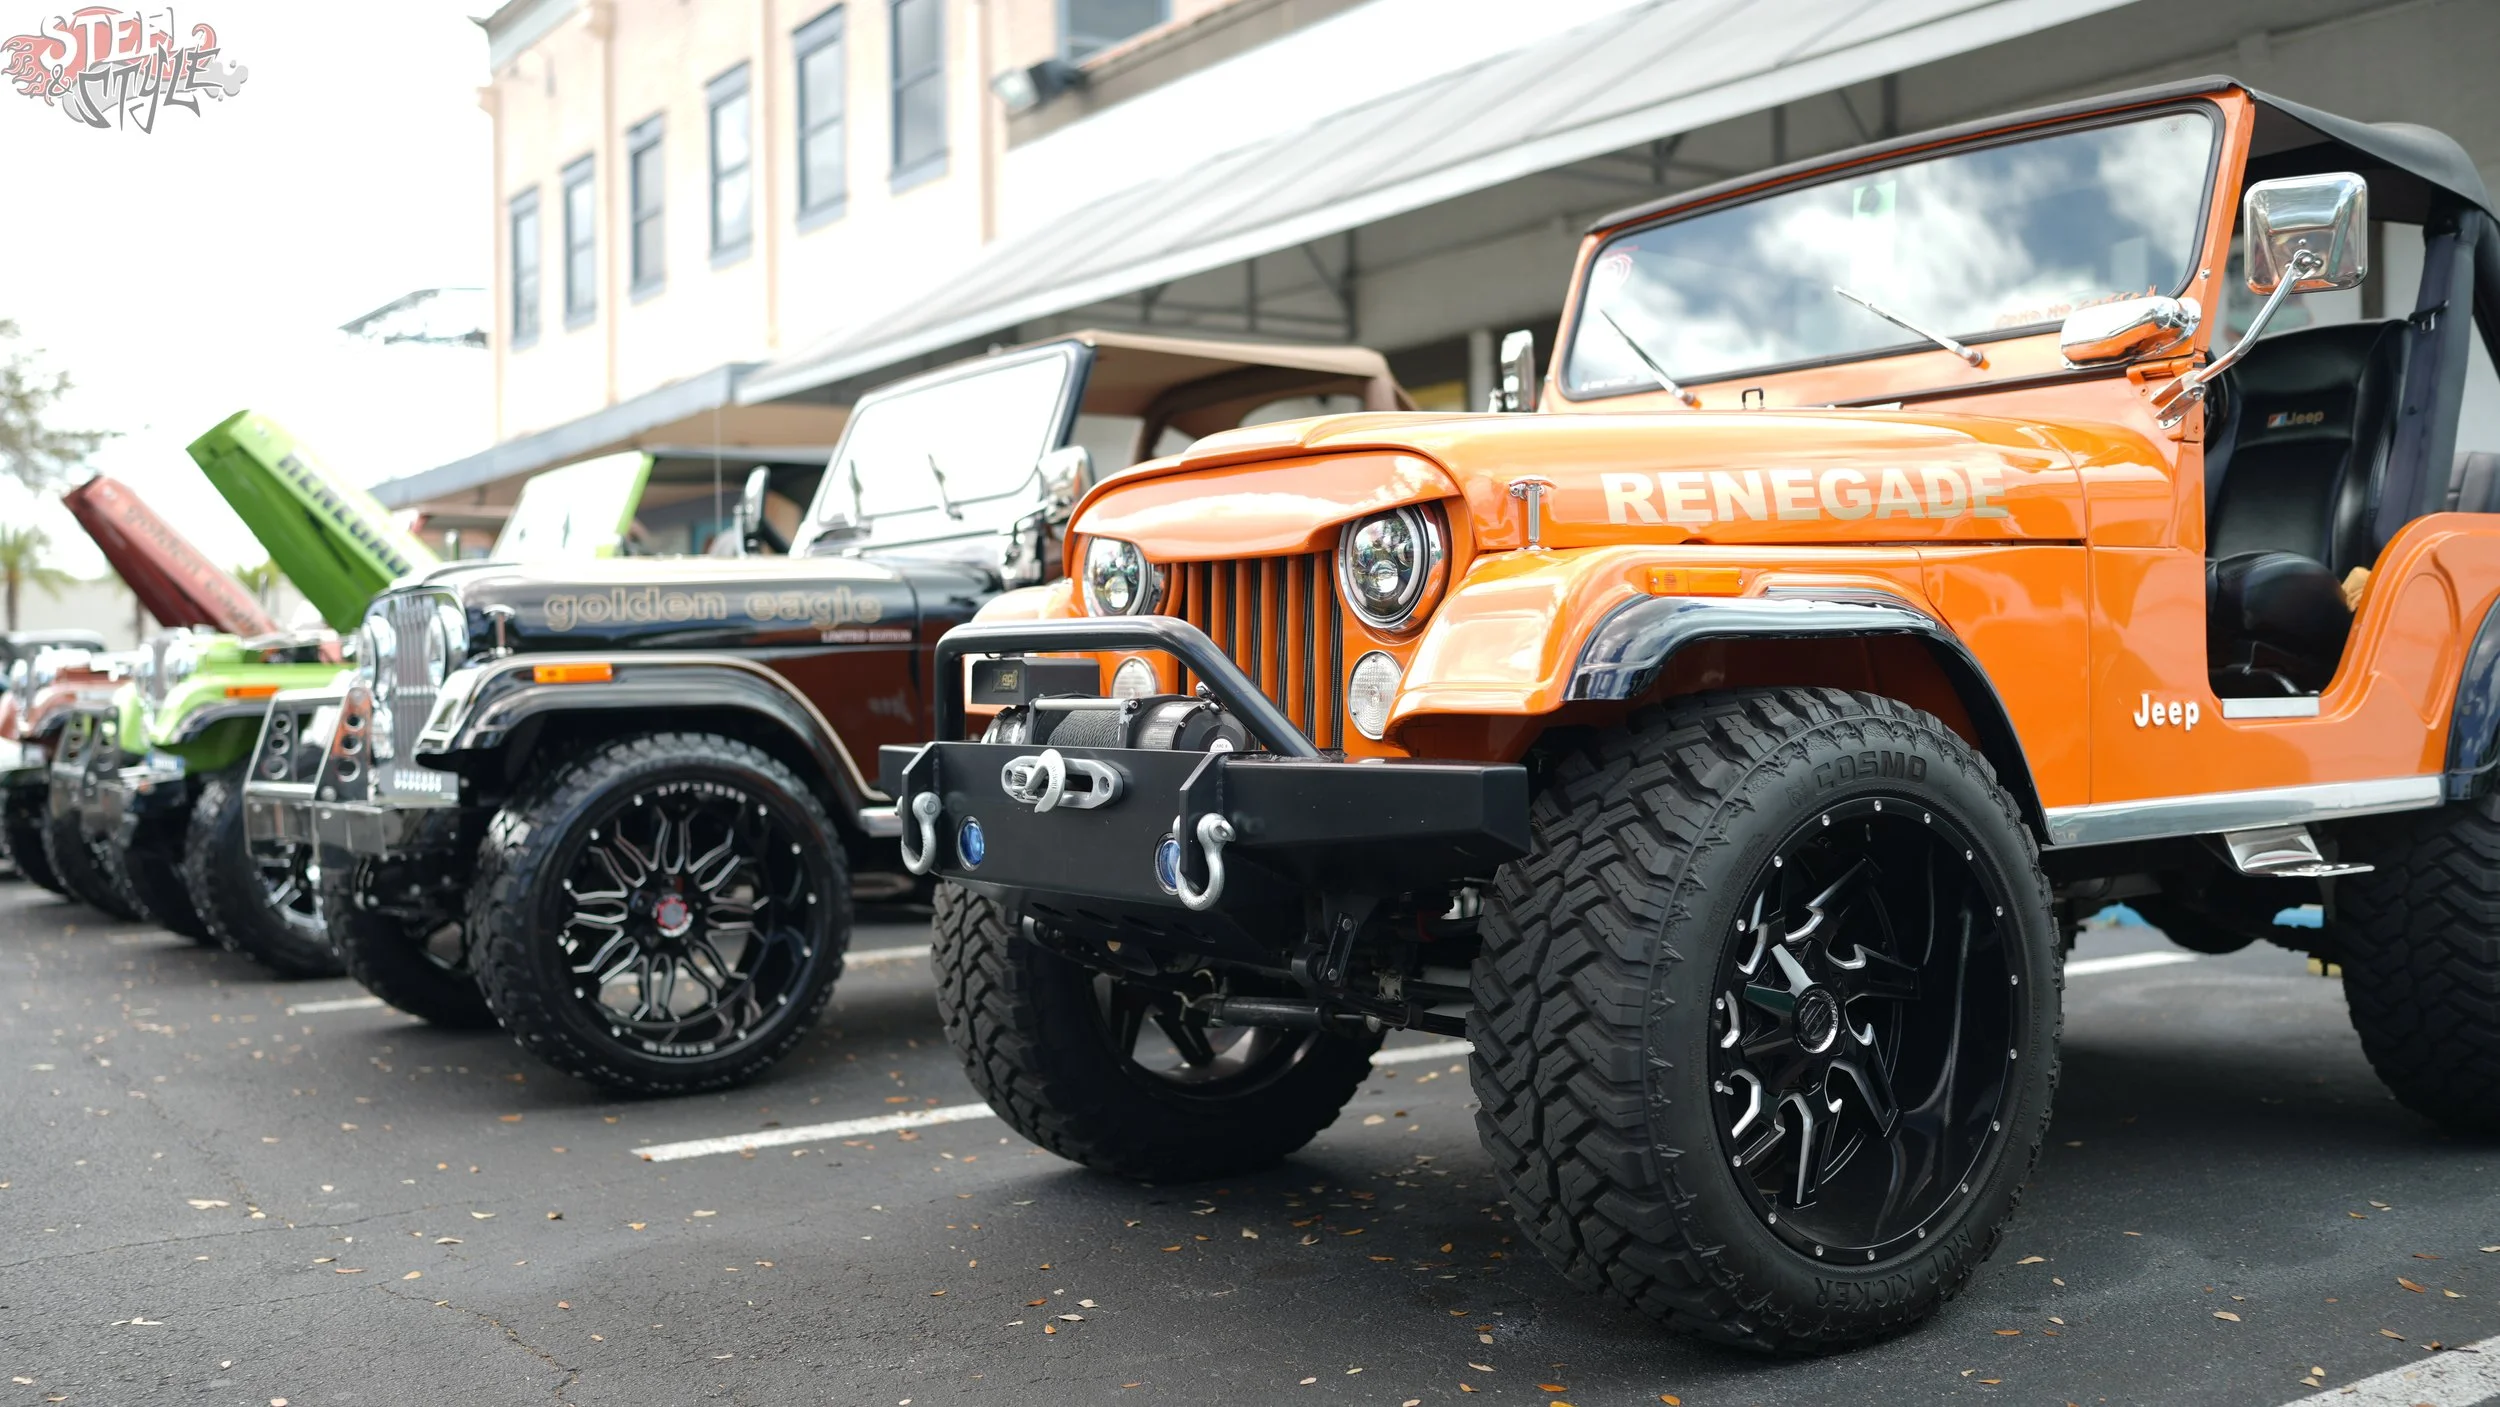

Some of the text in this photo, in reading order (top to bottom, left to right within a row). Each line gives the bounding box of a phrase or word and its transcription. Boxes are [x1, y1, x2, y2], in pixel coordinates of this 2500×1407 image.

[2286, 411, 2325, 426] Jeep
[1600, 467, 2010, 525] RENEGADE
[543, 584, 883, 633] golden eagle
[821, 628, 912, 644] LIMITED EDITION
[2132, 693, 2200, 732] Jeep
[1811, 750, 1928, 796] COSMO
[1814, 1268, 1917, 1313] KICKER
